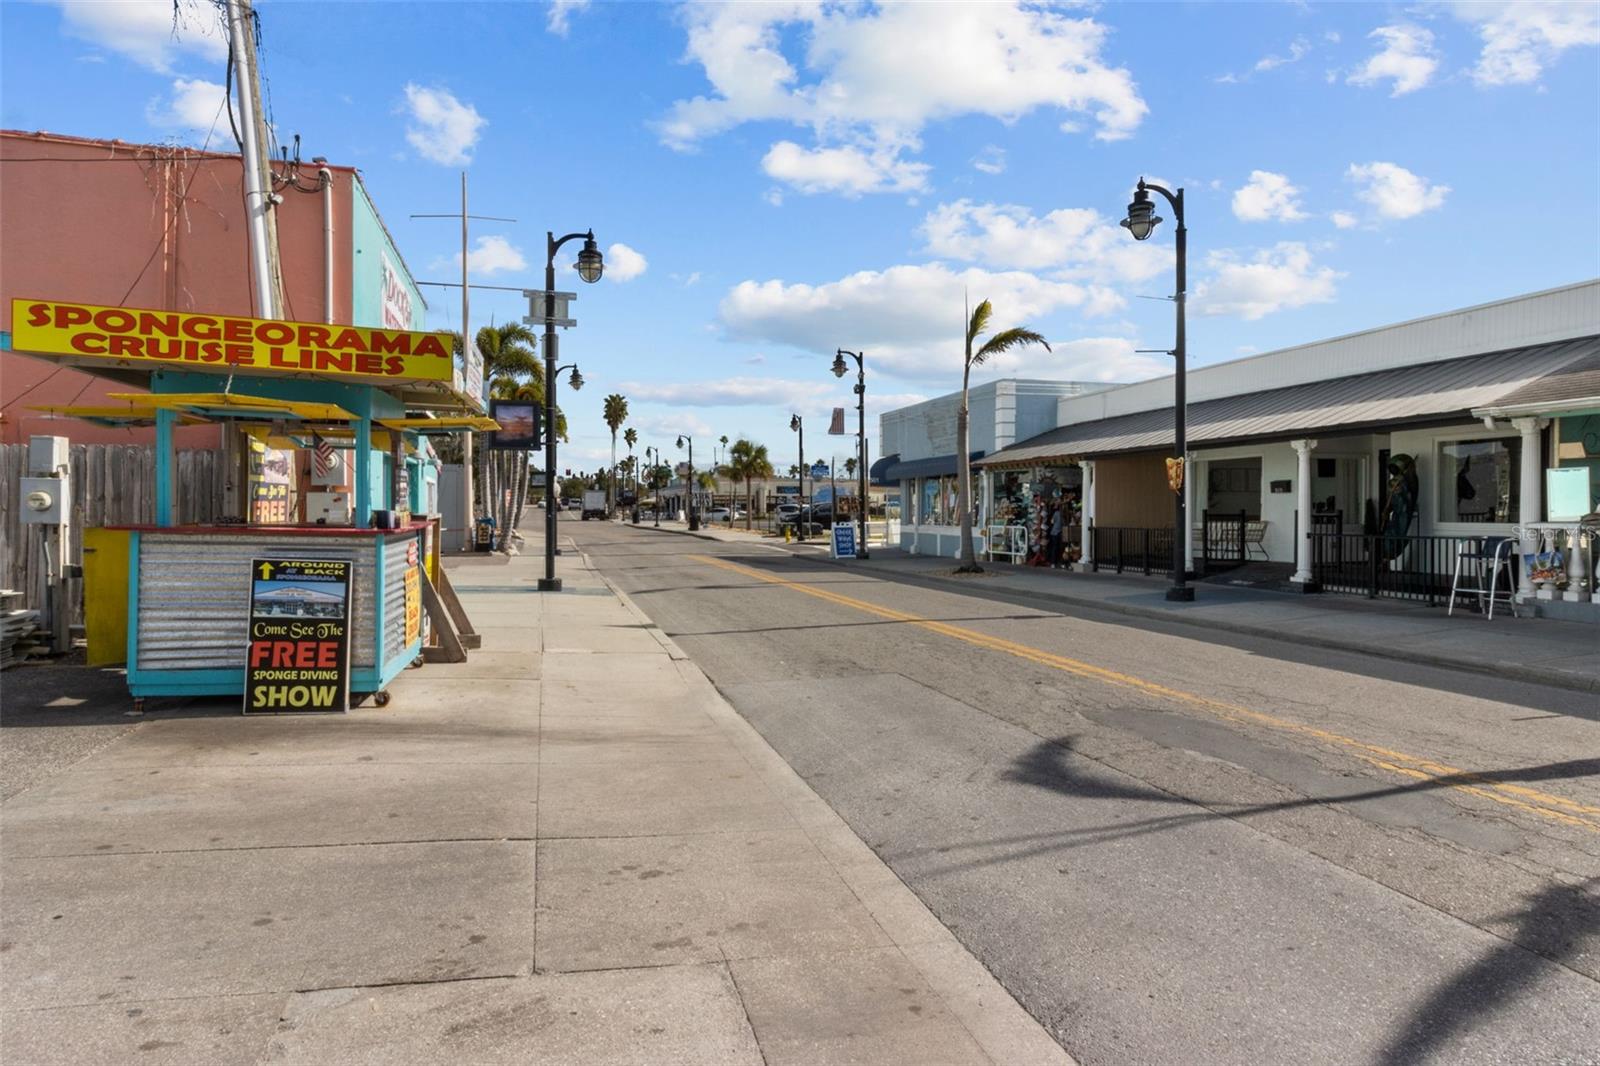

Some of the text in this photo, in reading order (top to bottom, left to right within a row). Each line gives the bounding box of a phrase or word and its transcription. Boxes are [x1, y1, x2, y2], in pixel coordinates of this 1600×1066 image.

[27, 303, 449, 357] SPONGEORAMA
[70, 332, 405, 375] CRUISE LINES
[253, 501, 286, 522] FREE
[279, 561, 345, 569] AROUND
[304, 568, 345, 576] BACK
[254, 622, 344, 639] Come See The
[251, 641, 339, 668] FREE
[253, 670, 338, 681] SPONGE DIVING
[253, 685, 338, 707] SHOW
